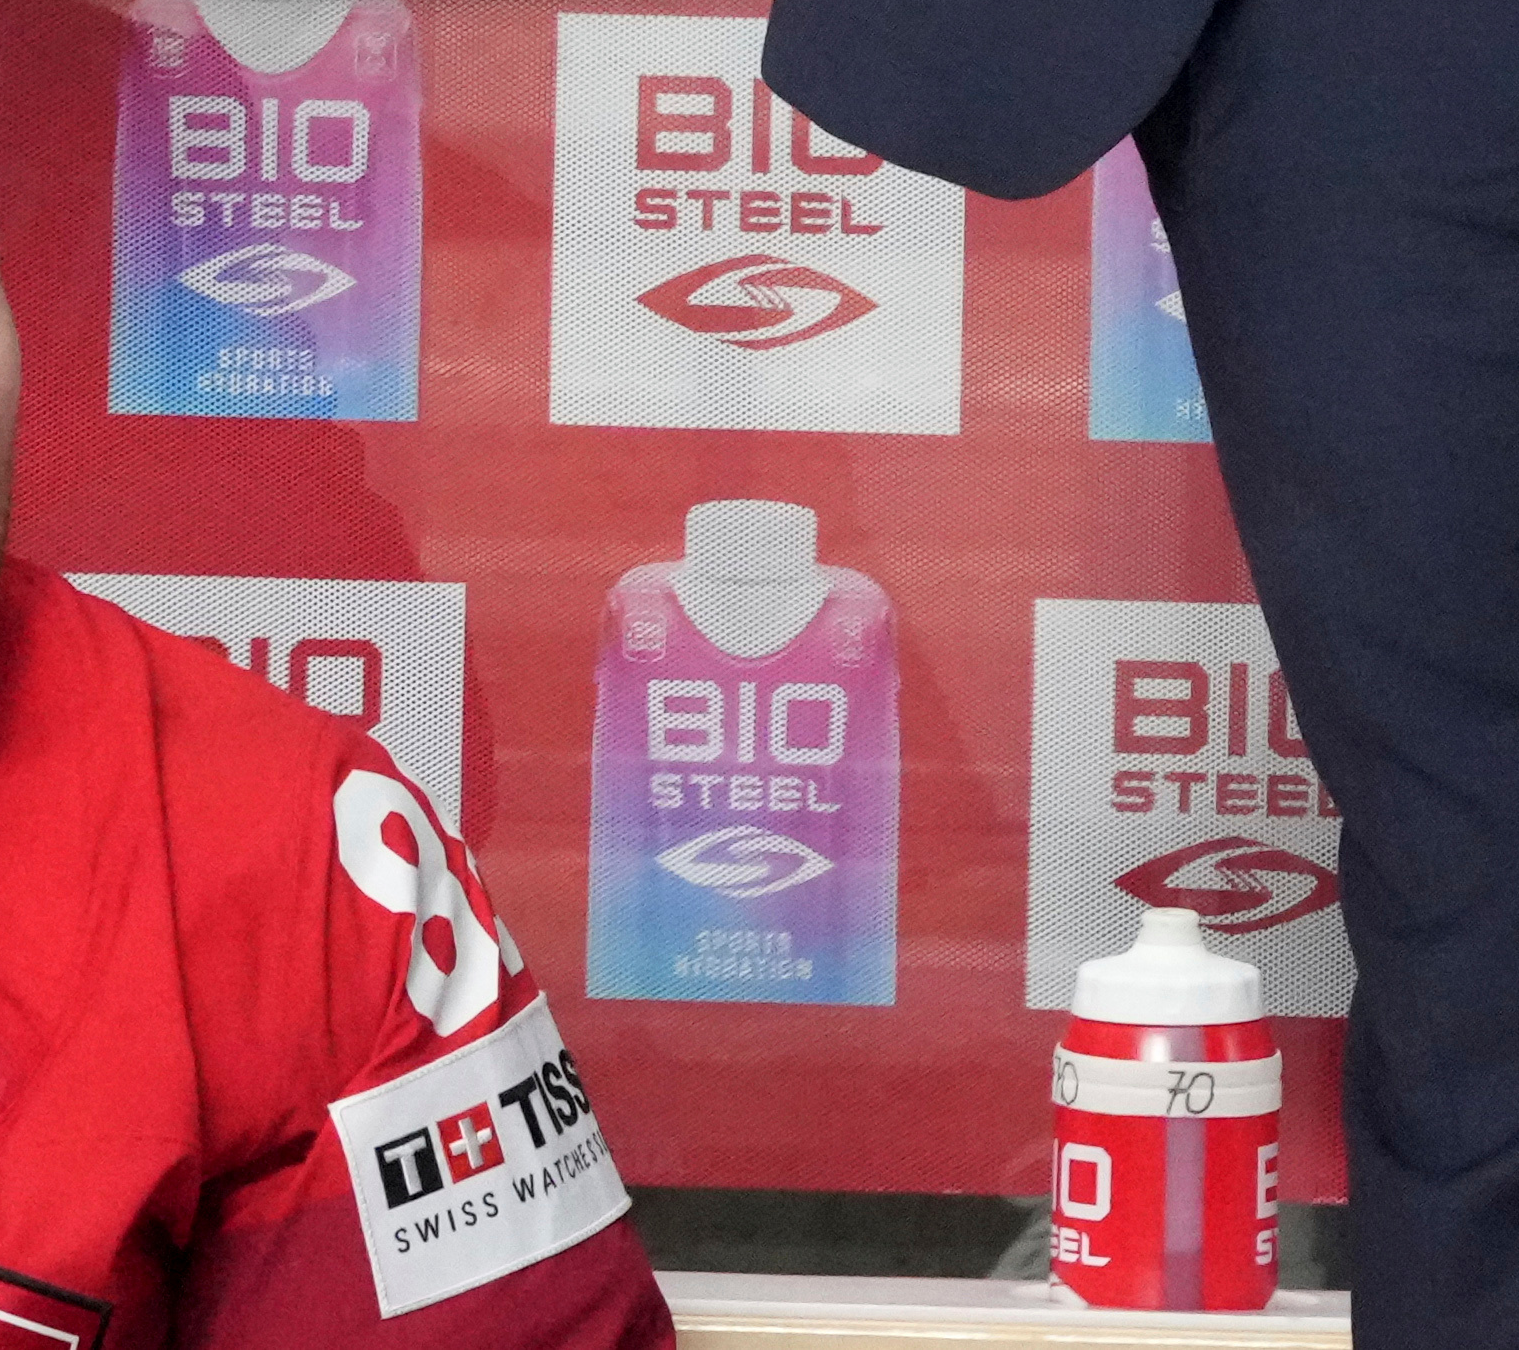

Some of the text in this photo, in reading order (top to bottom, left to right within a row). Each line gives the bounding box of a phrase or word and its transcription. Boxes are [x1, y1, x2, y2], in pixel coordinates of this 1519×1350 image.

[167, 97, 371, 183] BIO
[171, 191, 363, 231] STEEL
[634, 188, 883, 237] STEEL
[646, 679, 846, 765] BIO
[650, 772, 842, 813] STEEL
[334, 769, 525, 1038] 8
[1166, 1070, 1215, 1115] 70
[394, 1192, 499, 1254] SWISS
